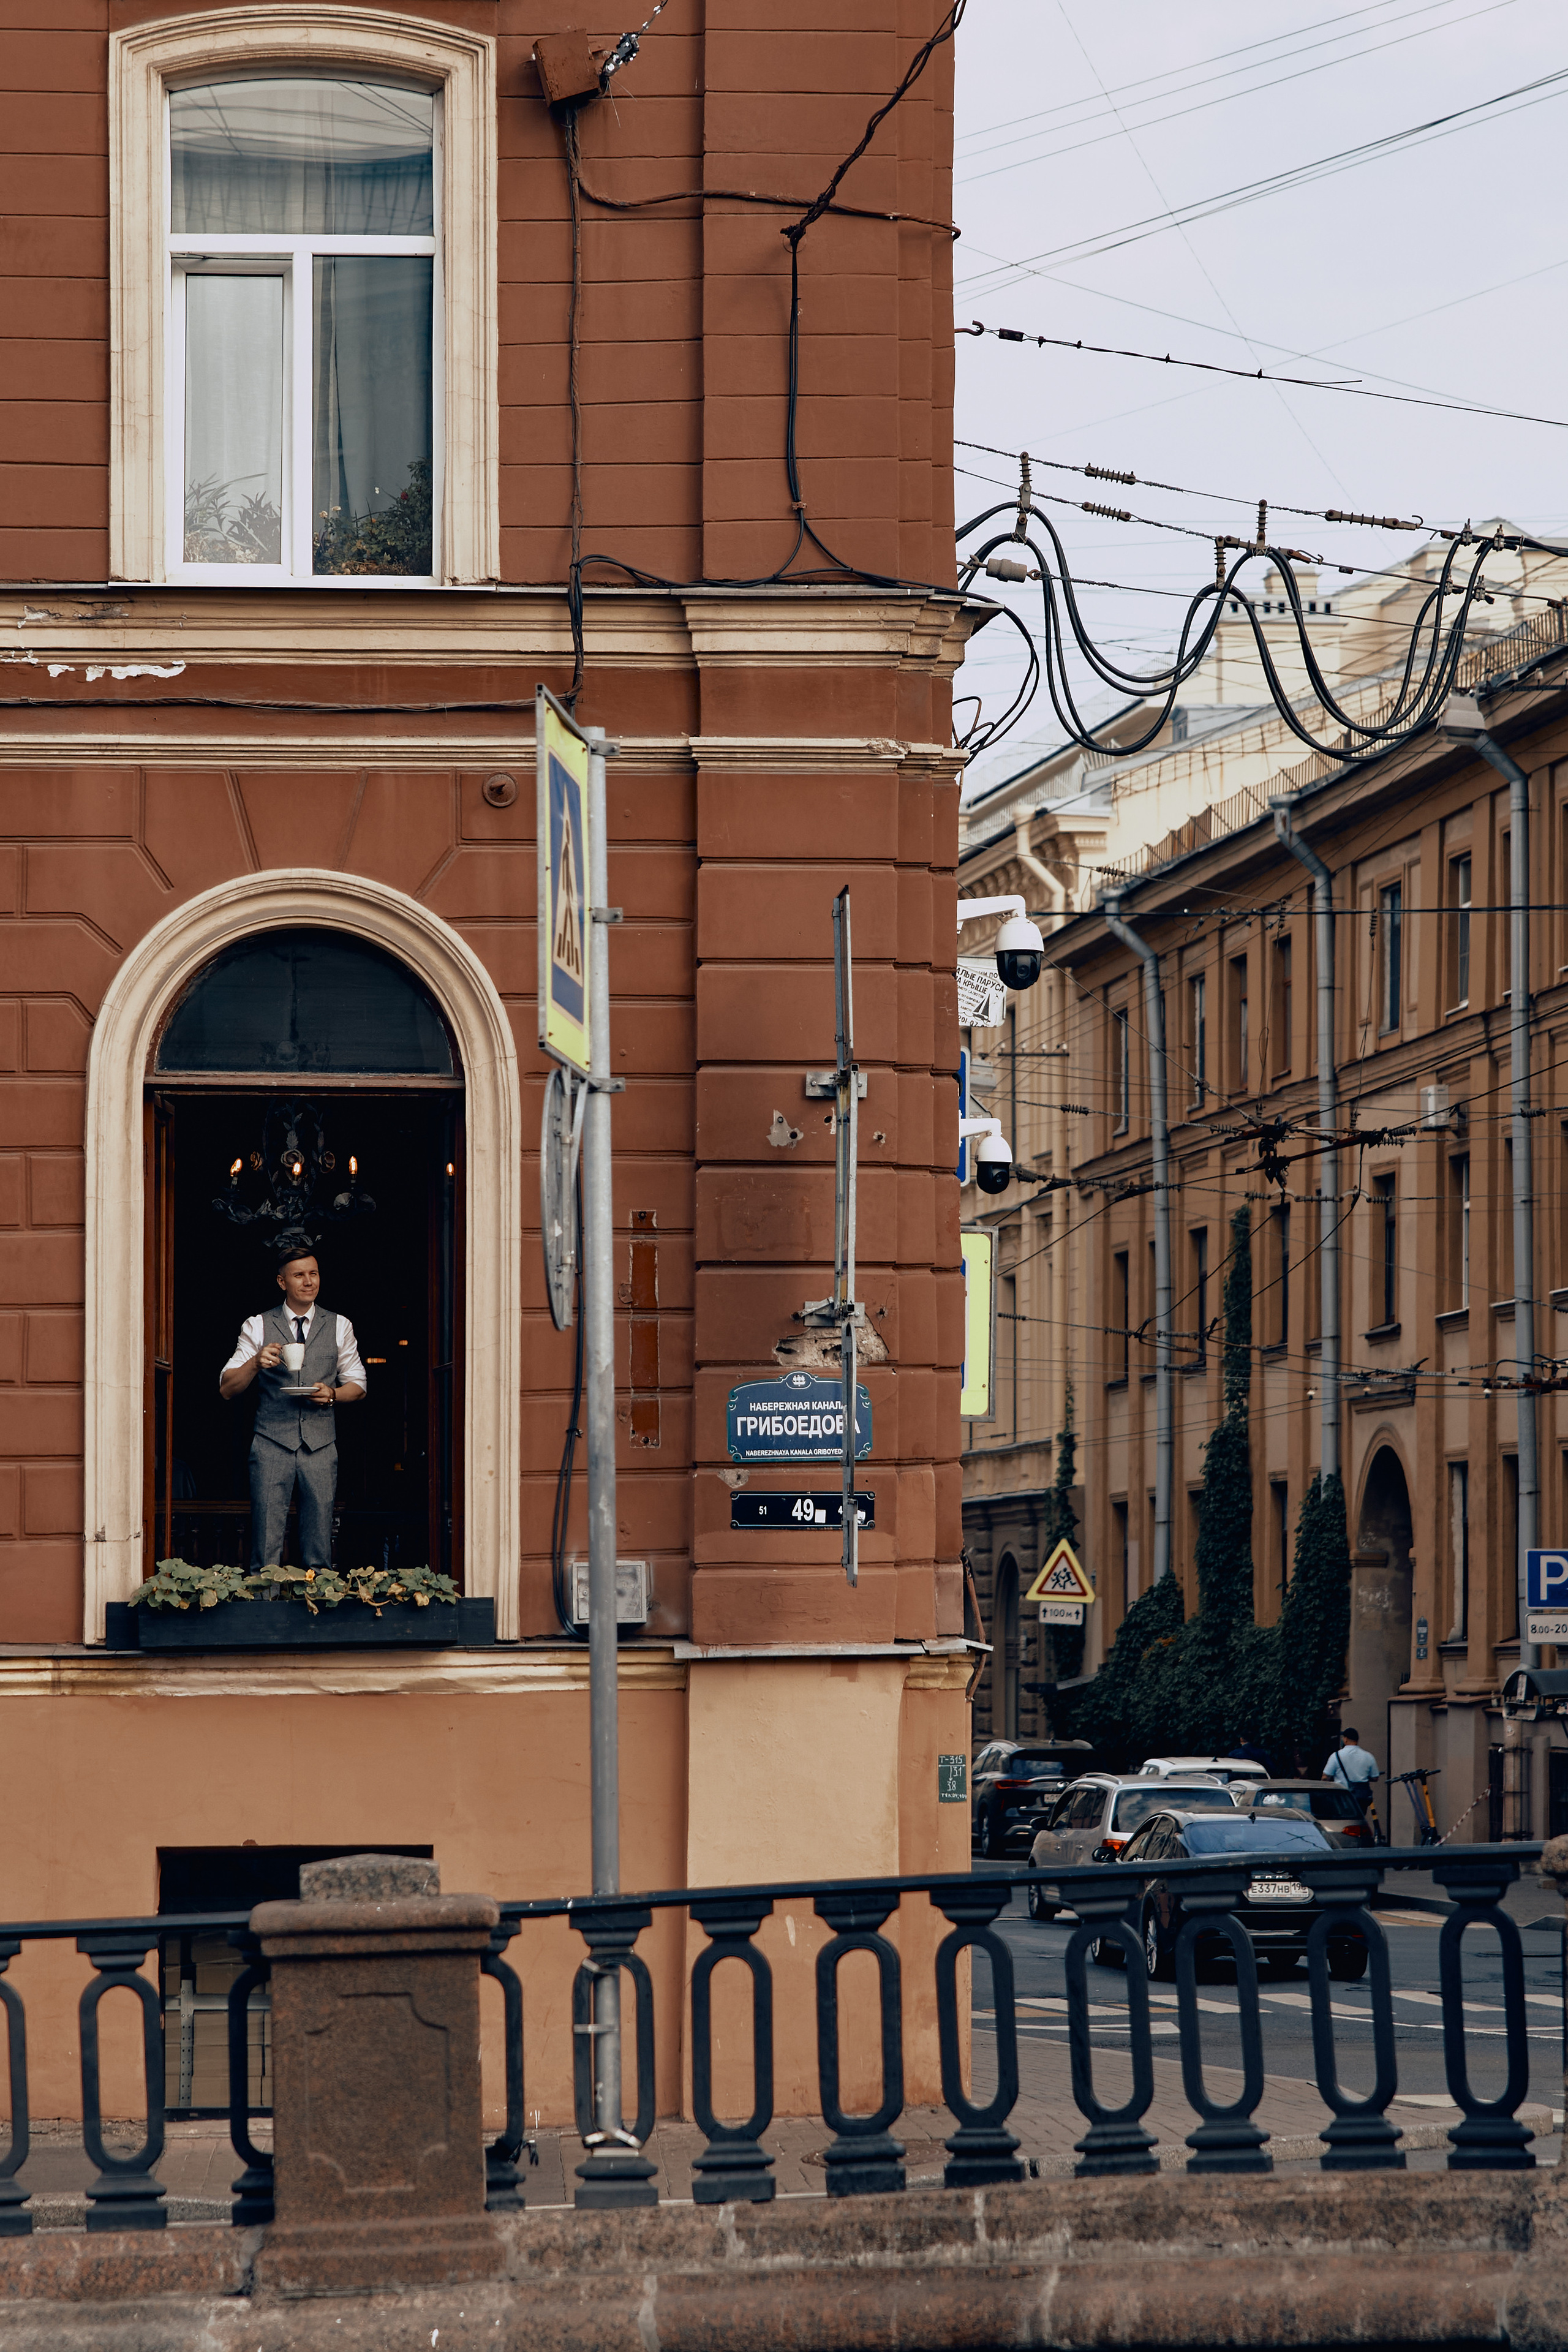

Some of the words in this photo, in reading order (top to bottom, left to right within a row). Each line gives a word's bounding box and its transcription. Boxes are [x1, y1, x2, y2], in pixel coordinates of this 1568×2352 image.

[963, 979, 988, 994] КРЫШЕ
[977, 976, 1004, 992] ПАРУСА
[750, 1401, 810, 1411] НАБЕРЕЖНАЯ
[812, 1401, 843, 1411] КАНАЛ
[759, 1506, 767, 1515] 51
[792, 1499, 814, 1521] 49
[1540, 1555, 1568, 1600] P
